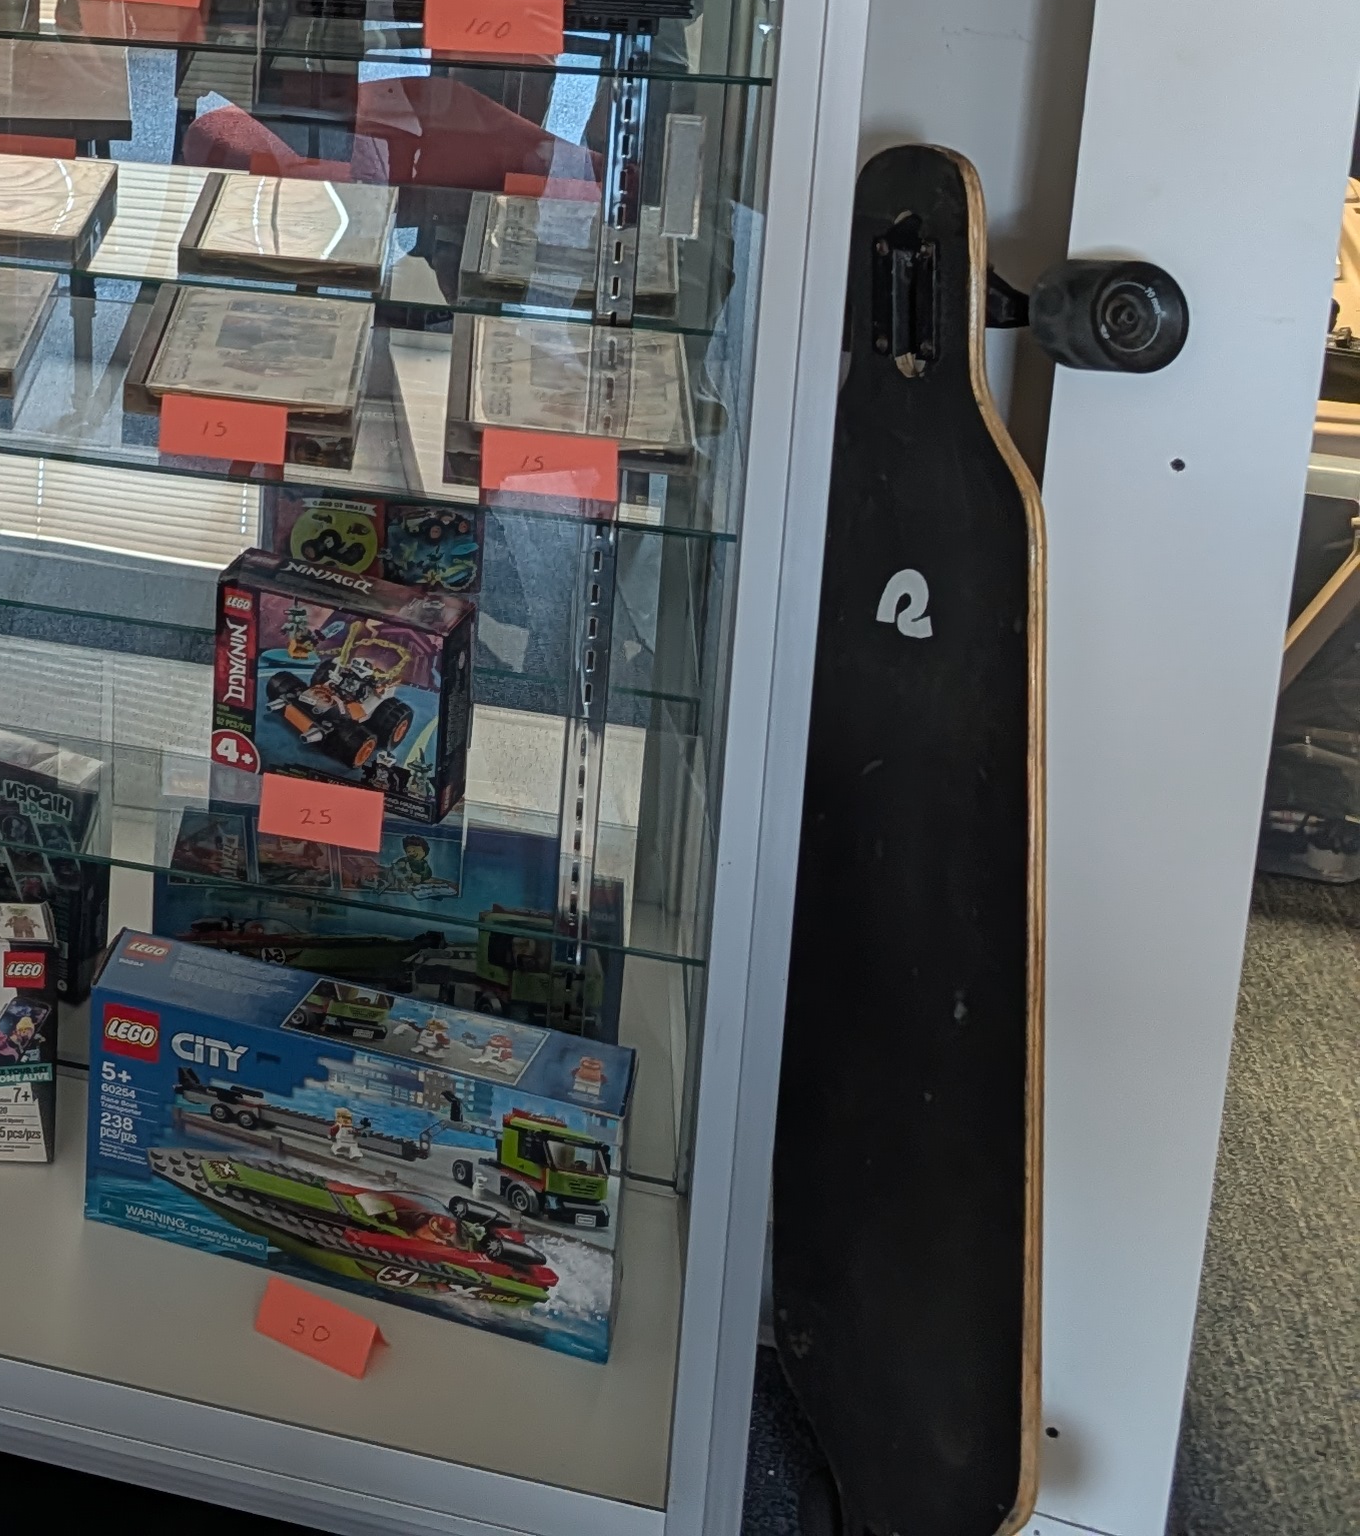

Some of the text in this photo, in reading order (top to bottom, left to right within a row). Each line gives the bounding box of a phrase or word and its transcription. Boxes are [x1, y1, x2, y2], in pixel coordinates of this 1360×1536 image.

[465, 18, 512, 39] 100
[202, 421, 228, 437] 15
[520, 455, 545, 472] 15
[285, 560, 374, 595] NINJAGO
[224, 594, 252, 610] LEGO
[222, 618, 247, 703] NINJAGO
[215, 737, 254, 765] 4+
[300, 808, 333, 825] 25
[130, 940, 167, 957] LEGO
[5, 959, 43, 980] LEGO
[105, 1017, 249, 1072] LEGO CITY
[5, 1067, 31, 1076] YOUR
[32, 1066, 49, 1074] SET
[18, 1072, 50, 1082] ALIVE
[101, 1061, 132, 1083] 5+
[13, 1086, 30, 1104] 7+
[101, 1083, 137, 1100] 60254
[100, 1112, 134, 1131] 238
[7, 1128, 42, 1141] pcs/pzs
[99, 1127, 138, 1145] pcs/pzs
[125, 1204, 189, 1232] WARNING:
[190, 1224, 230, 1242] CHOKING
[379, 1266, 416, 1286] 54
[291, 1316, 331, 1344] 50
